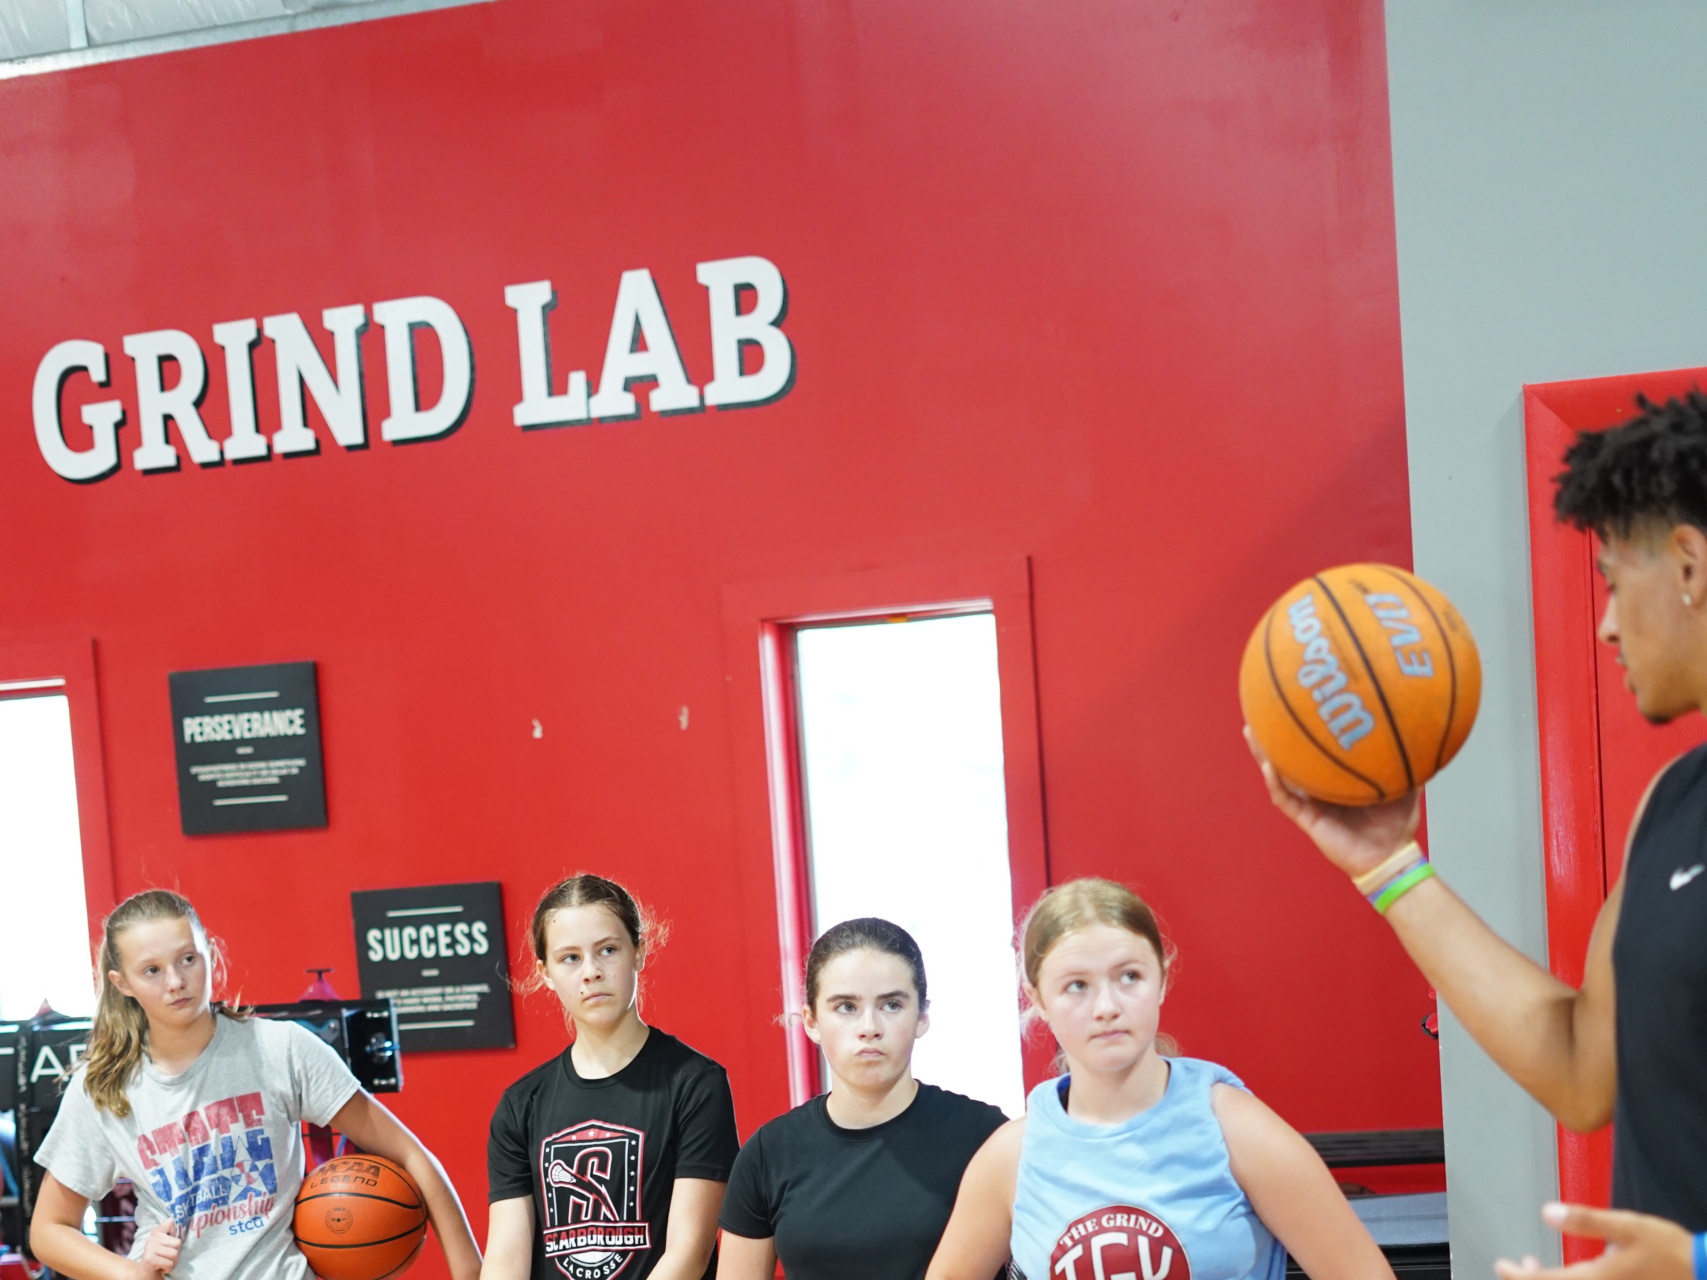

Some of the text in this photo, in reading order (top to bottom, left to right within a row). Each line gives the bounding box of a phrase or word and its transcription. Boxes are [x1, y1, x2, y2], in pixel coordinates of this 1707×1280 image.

[32, 255, 796, 482] GRIND LAB
[1287, 591, 1375, 752] Wilson
[183, 707, 306, 744] PERSEVERANCE
[366, 920, 489, 962] SUCCESS
[137, 1091, 277, 1205] STATE
[310, 1174, 378, 1189] LEGEND
[229, 1215, 265, 1236] stcu
[545, 1226, 644, 1253] SCARBOROUGH
[1059, 1213, 1164, 1248] THE GRIND
[562, 1253, 623, 1279] LACROSSE
